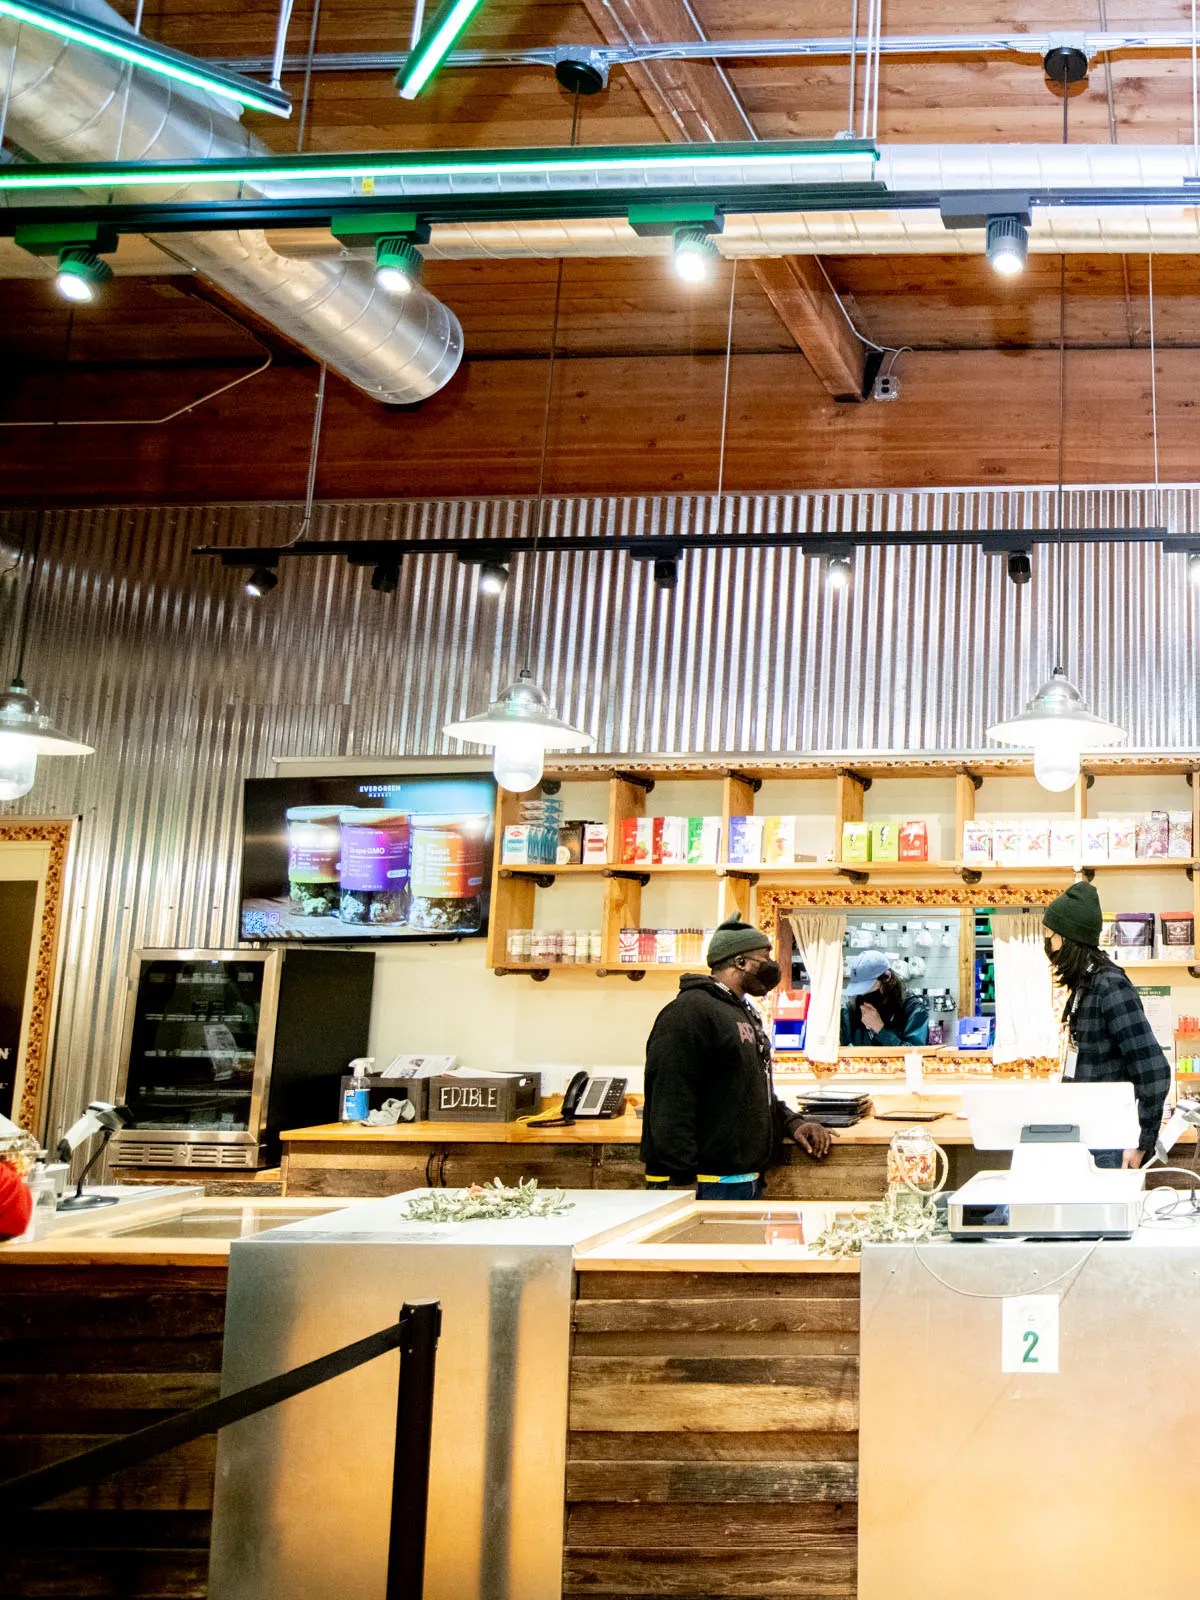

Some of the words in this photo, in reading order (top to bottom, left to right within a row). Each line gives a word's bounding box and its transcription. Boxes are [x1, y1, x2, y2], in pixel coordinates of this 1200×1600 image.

[359, 785, 401, 793] EVERGREEN
[440, 1086, 497, 1109] EDIBLE
[1022, 1330, 1039, 1363] 2
